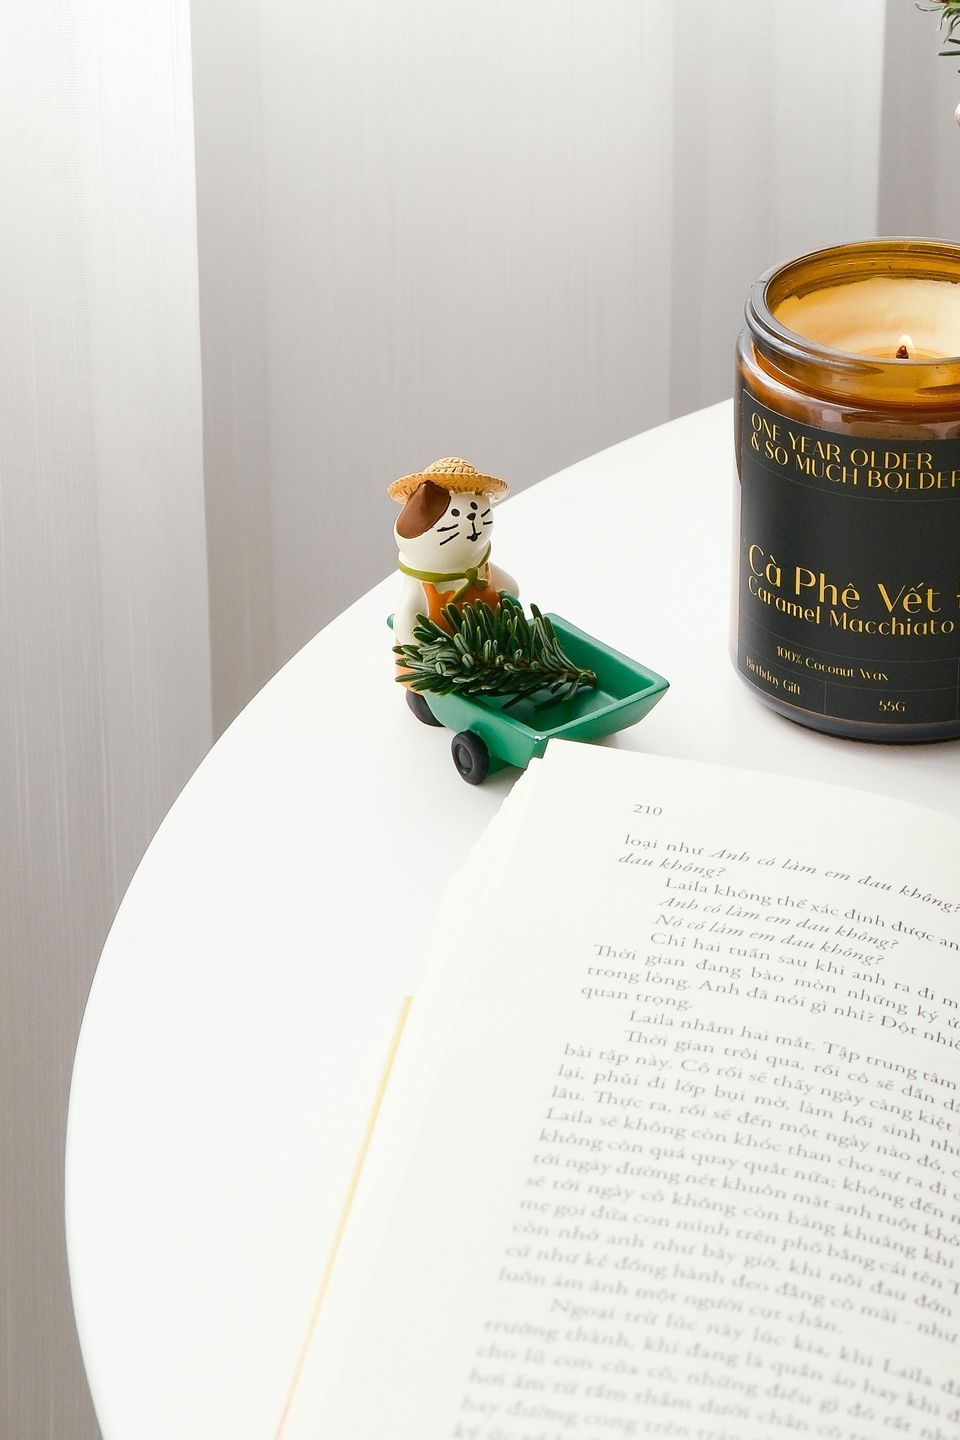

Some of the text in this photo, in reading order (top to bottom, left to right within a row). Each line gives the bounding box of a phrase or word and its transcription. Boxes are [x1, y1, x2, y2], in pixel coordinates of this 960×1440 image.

[751, 412, 933, 471] ONE YEAR OLDER
[751, 433, 760, 452] &
[764, 440, 789, 466] SO
[795, 454, 859, 486] MUCH
[748, 544, 782, 589] Cà
[795, 566, 860, 610] Phê
[877, 581, 942, 614] Vết
[748, 575, 955, 636] Caramel Macchiato
[746, 655, 801, 695] Birthday Gift
[776, 645, 889, 682] 100% Coconut Wax
[632, 803, 663, 815] 210
